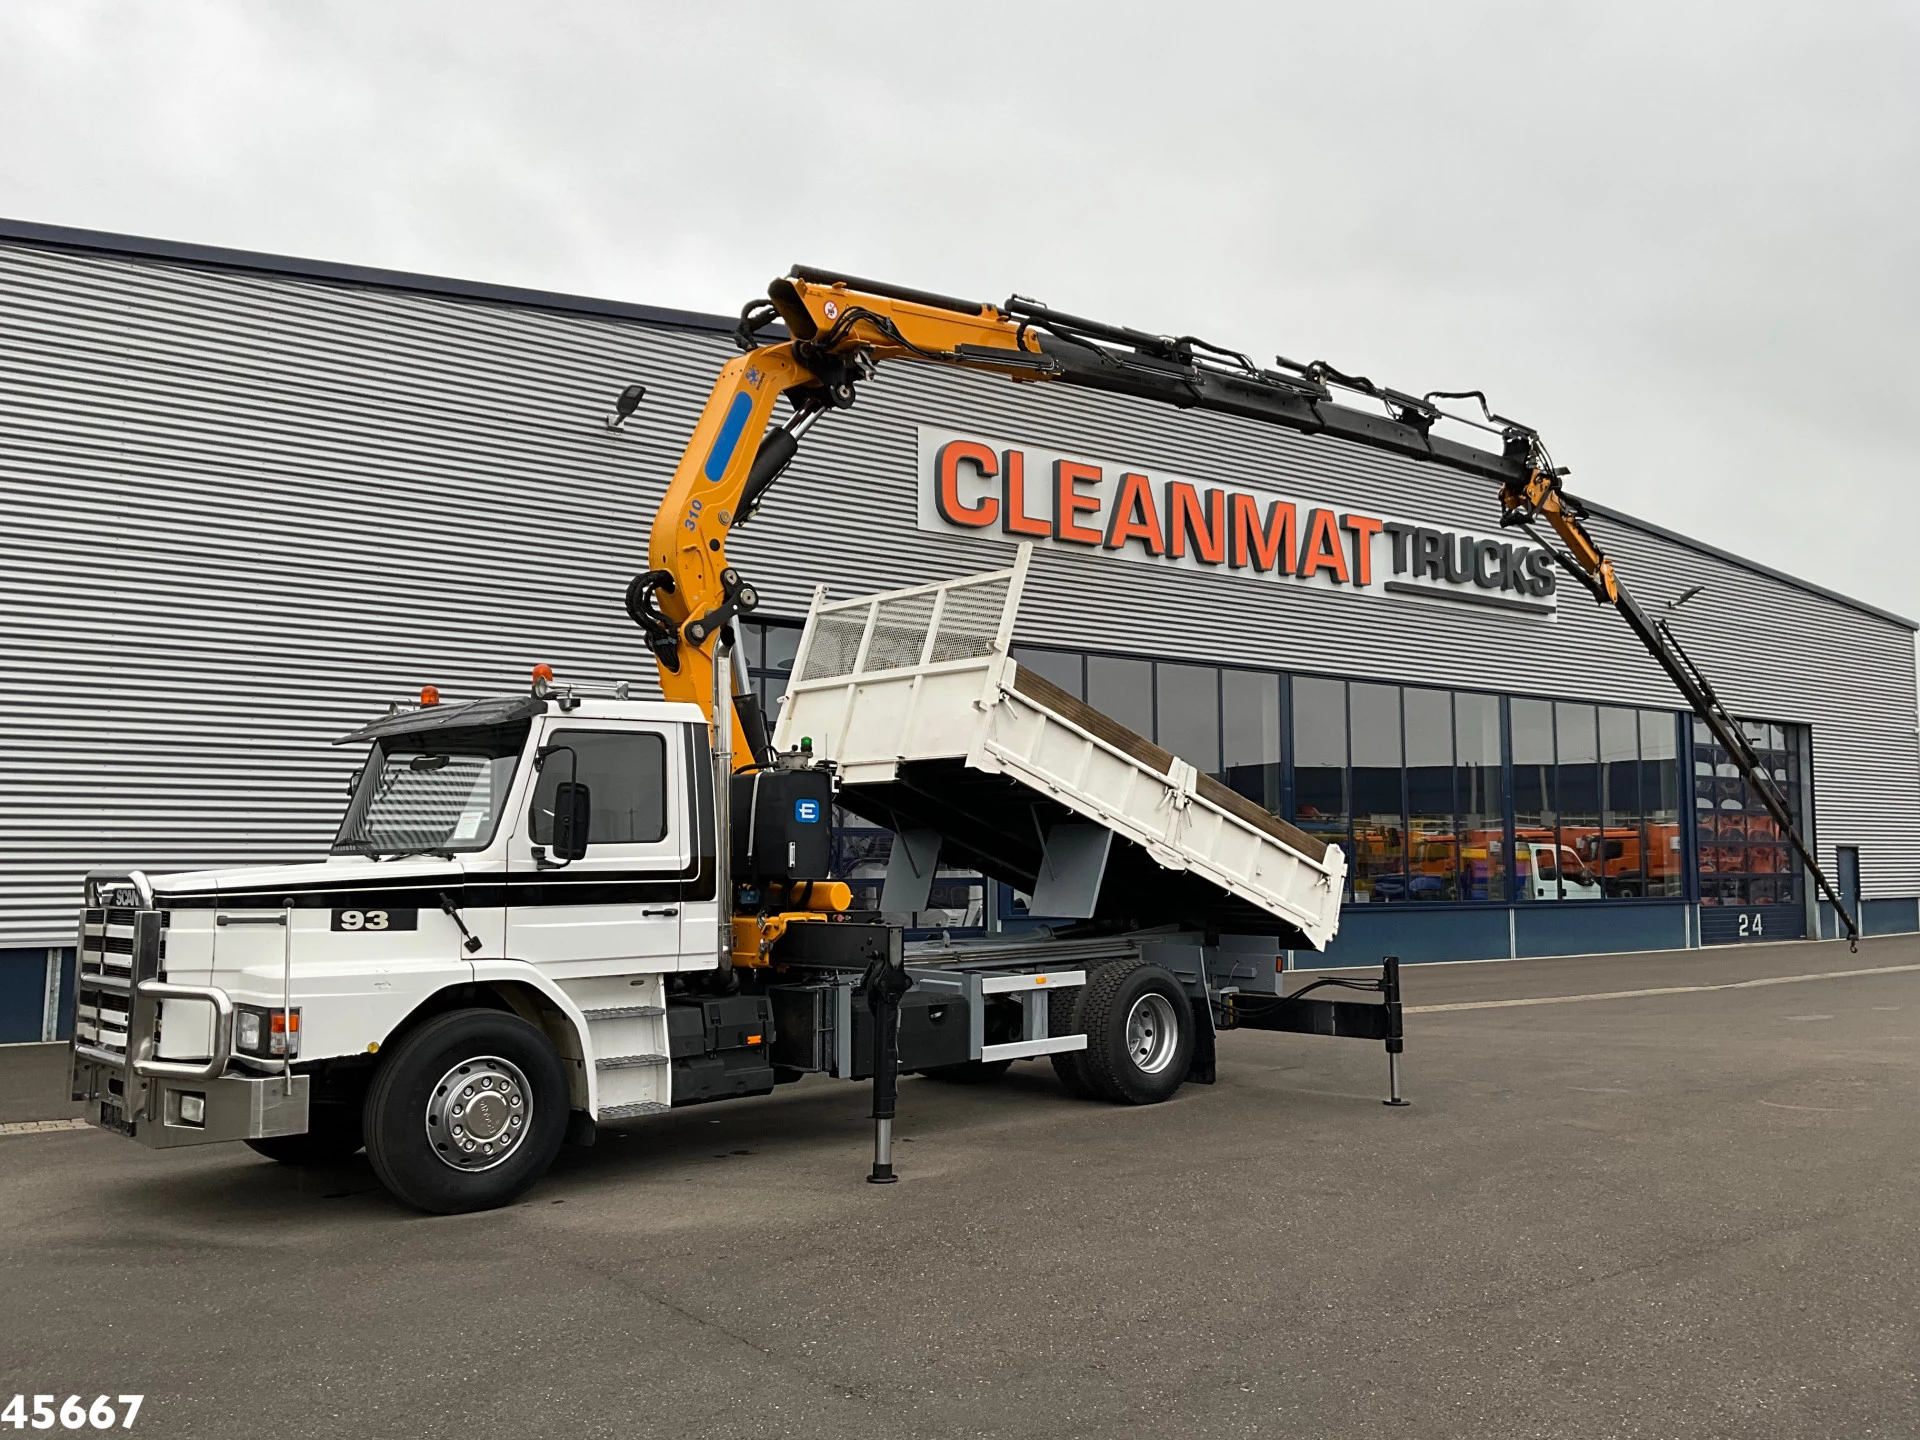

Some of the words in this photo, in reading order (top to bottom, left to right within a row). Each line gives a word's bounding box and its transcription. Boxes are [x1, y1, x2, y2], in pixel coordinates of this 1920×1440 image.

[684, 499, 703, 532] 310
[935, 440, 1382, 586] CLEANMAT
[1383, 522, 1556, 597] TRUCKS
[116, 889, 140, 906] SCAN
[341, 910, 389, 930] 93
[1738, 913, 1763, 937] 24
